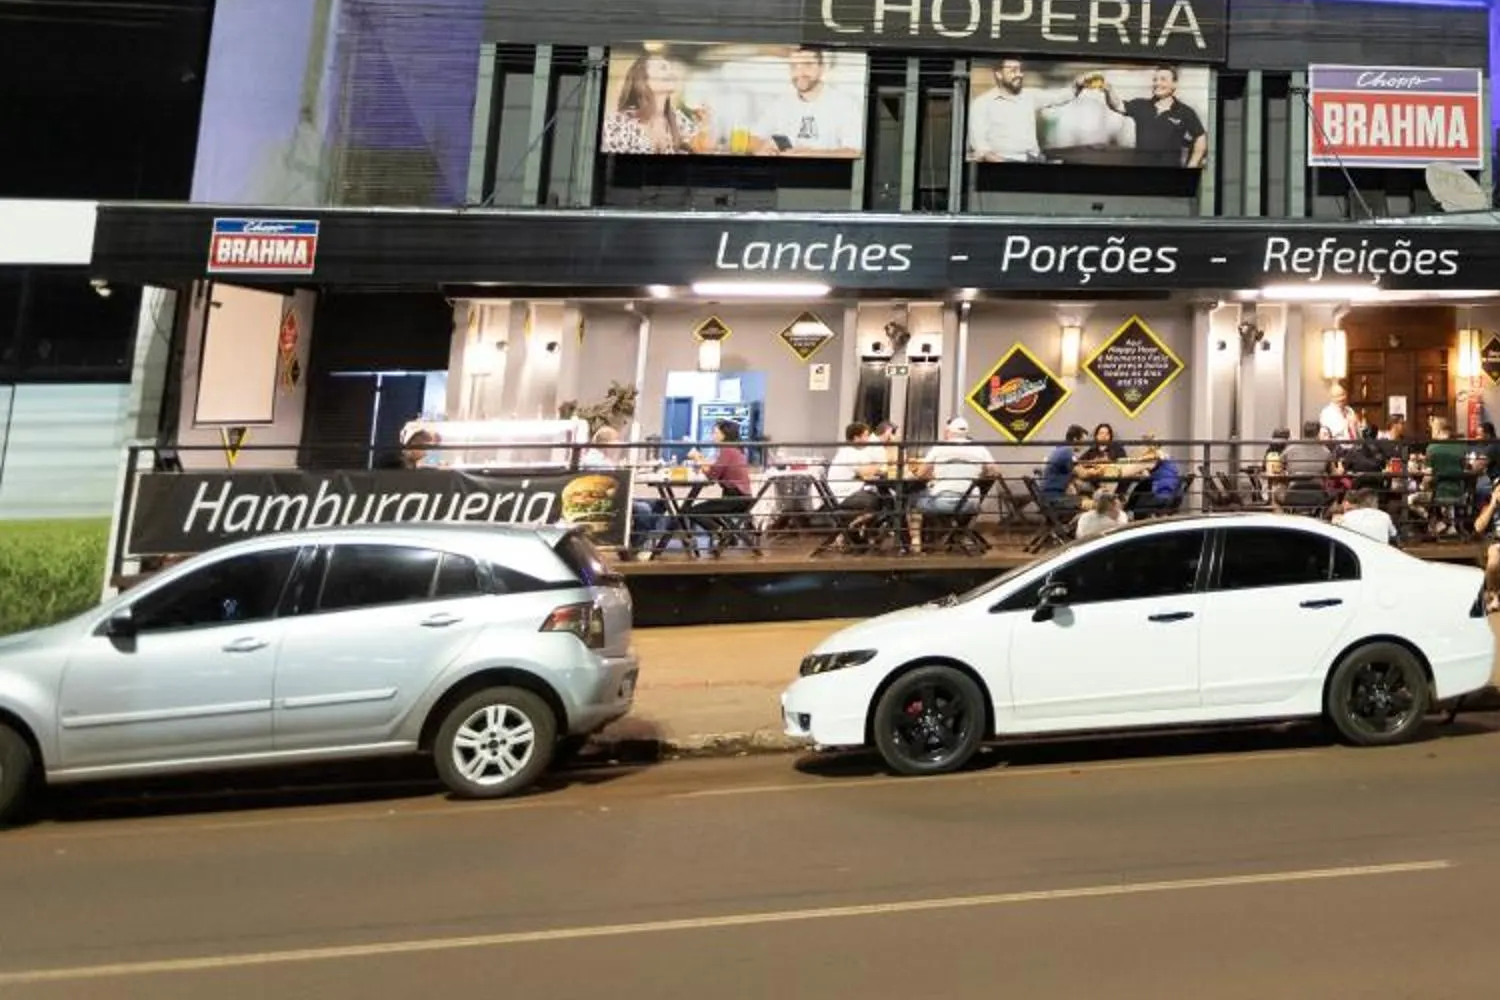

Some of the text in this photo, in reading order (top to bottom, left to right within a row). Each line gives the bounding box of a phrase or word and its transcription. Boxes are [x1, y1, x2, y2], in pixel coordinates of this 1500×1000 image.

[1323, 102, 1469, 149] BRAHMA
[216, 238, 308, 265] BRAHMA
[715, 231, 913, 272] Lanches
[1001, 235, 1179, 283] Porções
[1262, 236, 1460, 285] Refeições
[182, 479, 556, 534] Hamburgueria
